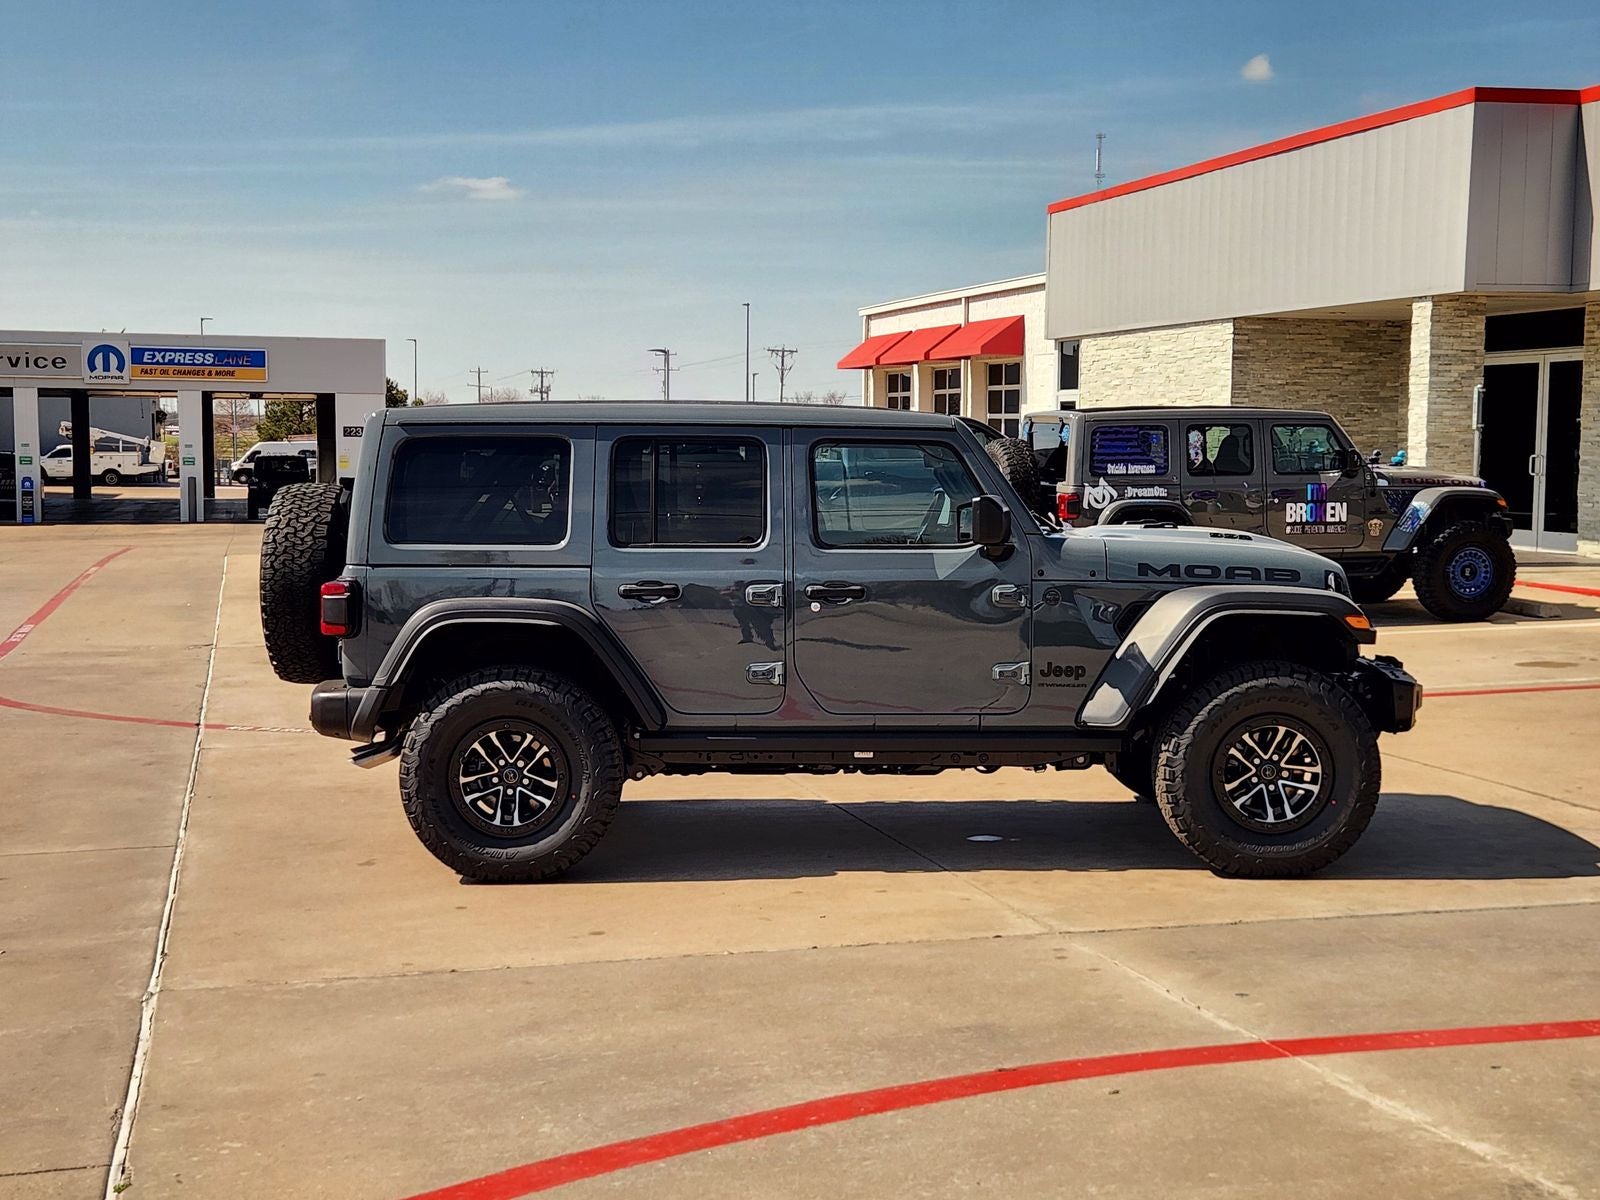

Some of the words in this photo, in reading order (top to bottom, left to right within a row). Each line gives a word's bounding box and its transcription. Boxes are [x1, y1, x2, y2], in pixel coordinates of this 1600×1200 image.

[0, 352, 67, 369] vice
[143, 351, 214, 364] EXPRESS
[160, 368, 170, 376] OIL
[1400, 477, 1474, 487] RUBICON
[1285, 502, 1348, 523] BROKEN
[1137, 562, 1302, 582] MOAB
[1039, 662, 1087, 681] Jeep
